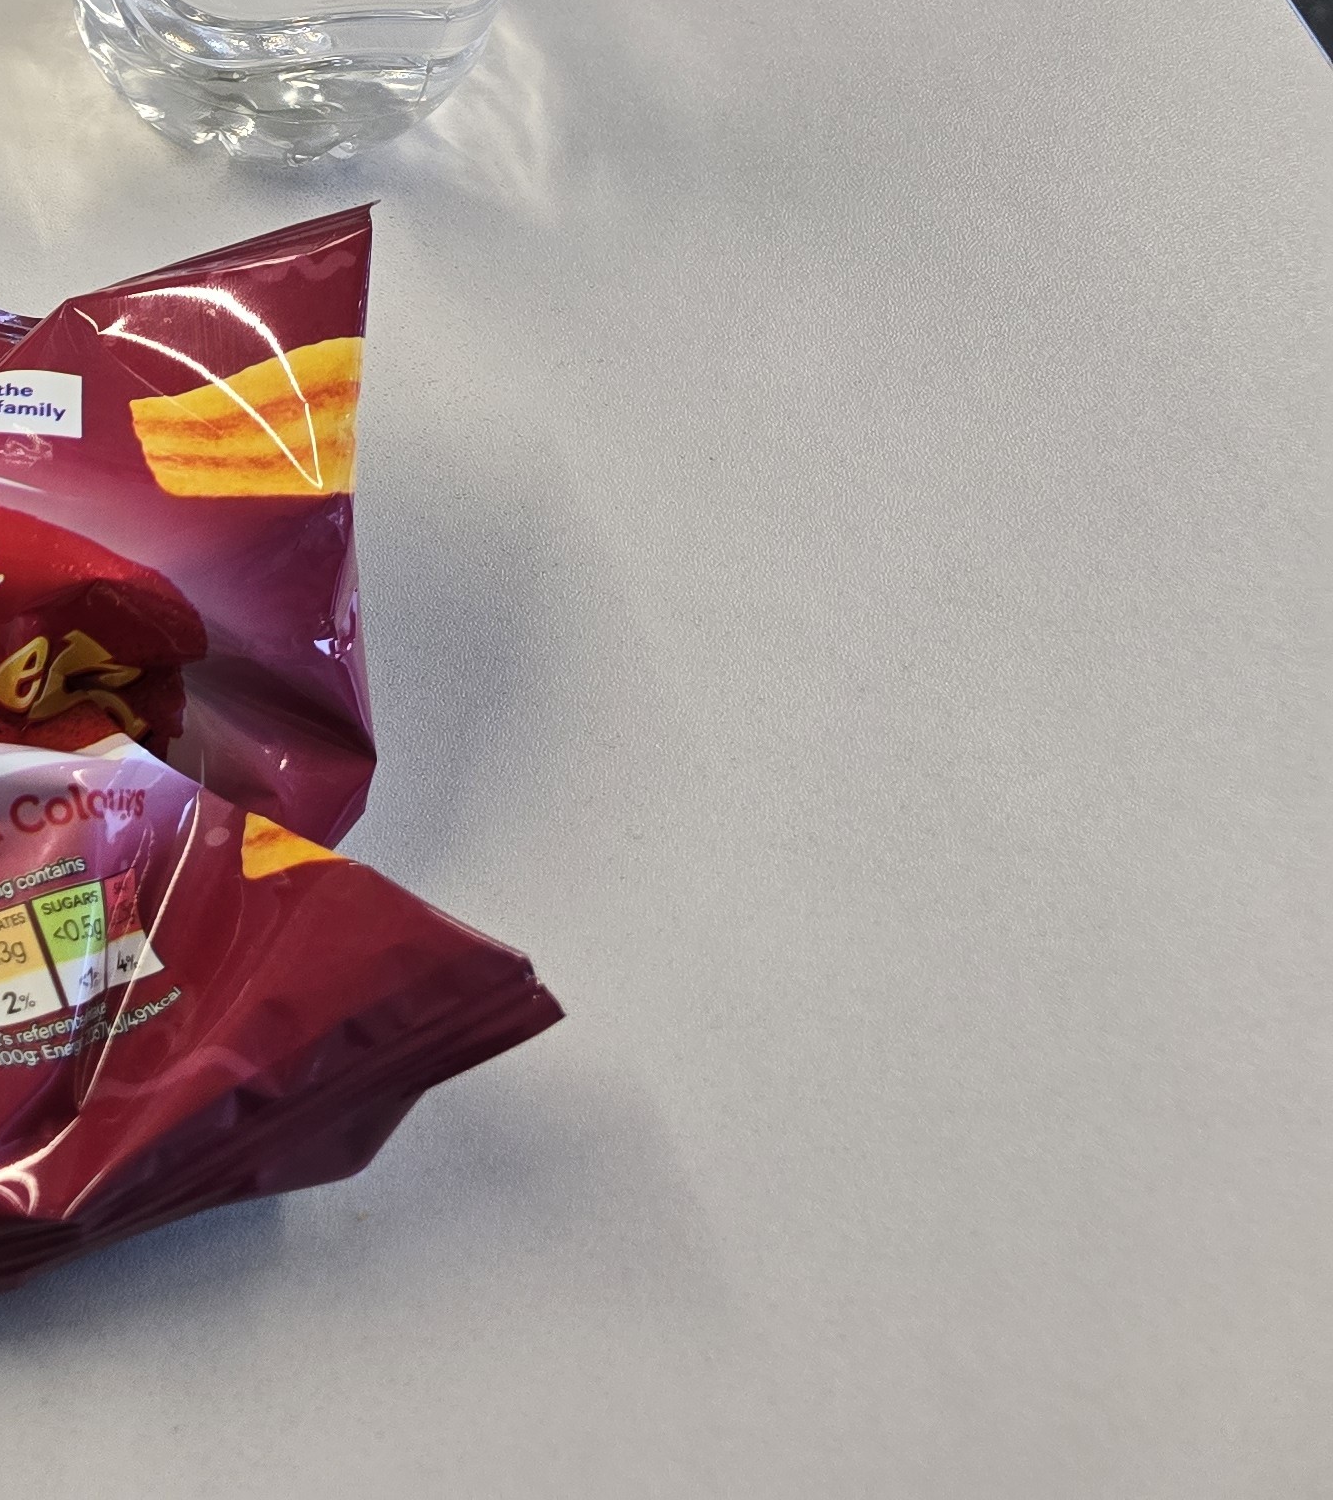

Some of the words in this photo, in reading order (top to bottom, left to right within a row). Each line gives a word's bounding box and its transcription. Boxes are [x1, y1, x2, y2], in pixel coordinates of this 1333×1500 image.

[16, 858, 86, 890] contains
[41, 890, 99, 916] SUGARS
[2, 992, 37, 1017] 2%
